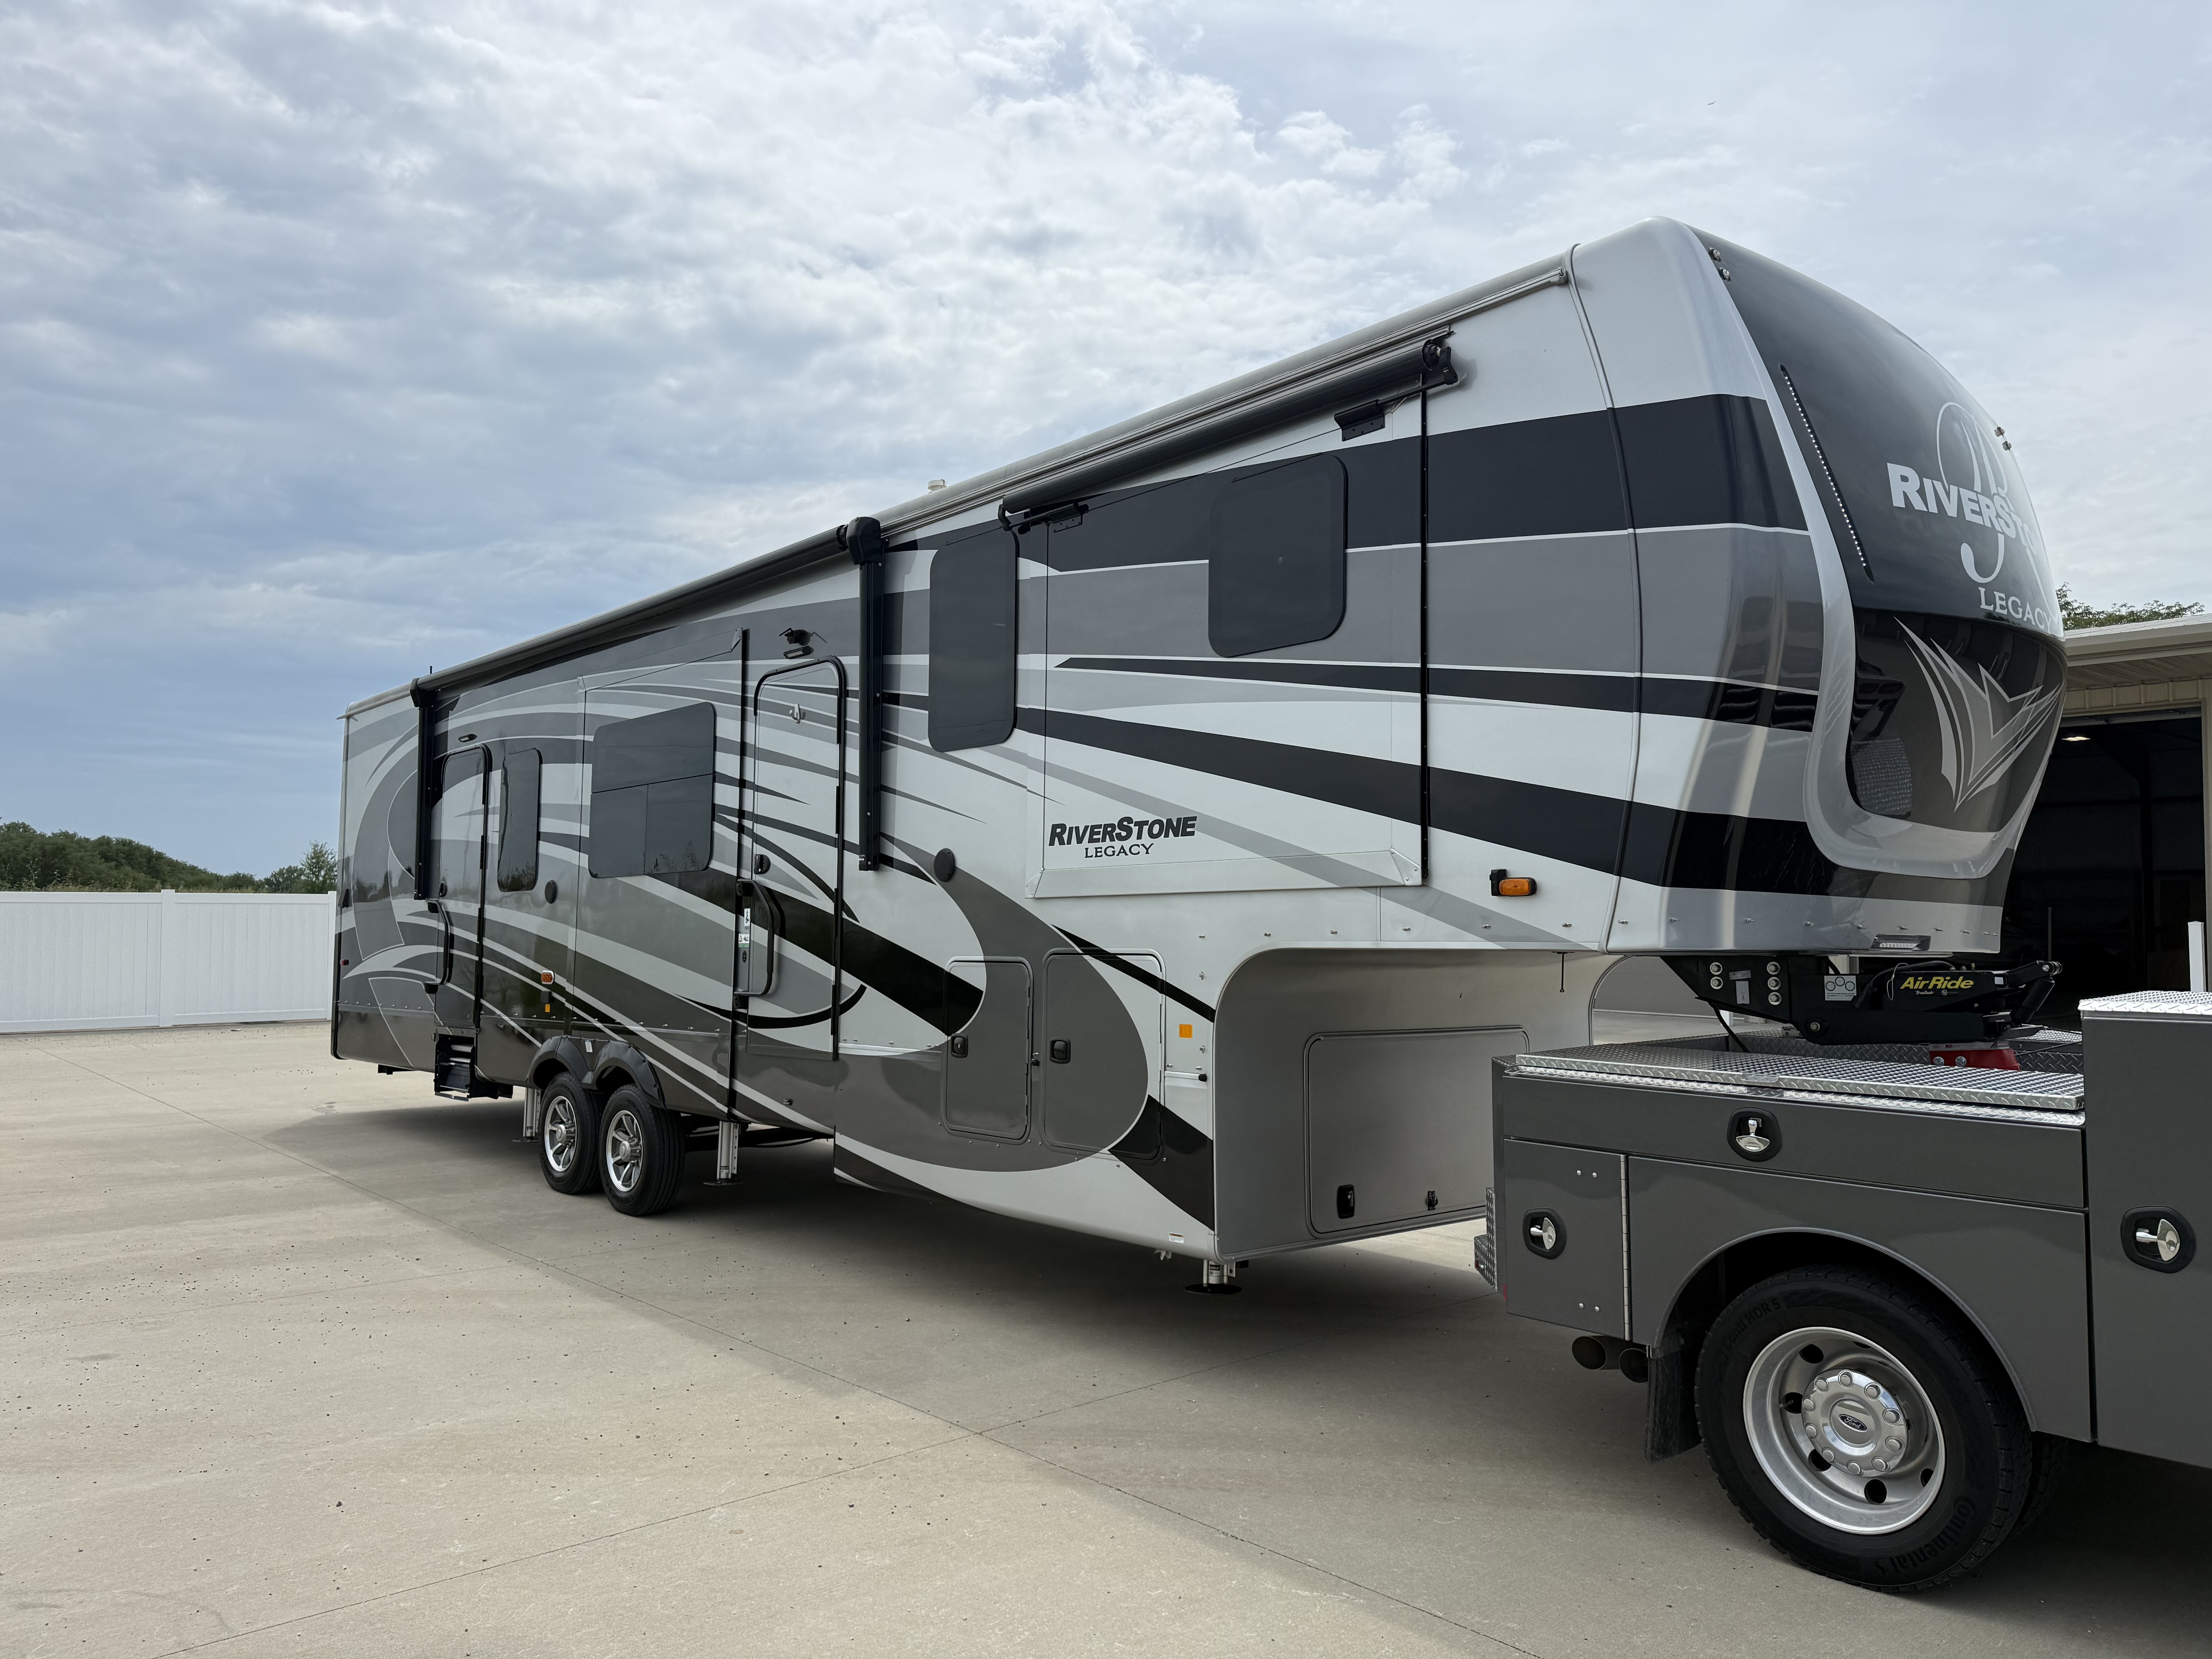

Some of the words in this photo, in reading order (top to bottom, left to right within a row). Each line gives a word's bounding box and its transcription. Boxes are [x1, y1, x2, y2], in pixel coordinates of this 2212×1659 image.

[1978, 587, 2051, 634] LEGACY
[1049, 816, 1197, 846] RIVERSTONE
[1084, 843, 1154, 858] LEGACY
[1771, 1298, 1781, 1310] 5
[1889, 1496, 1978, 1574] Continental
